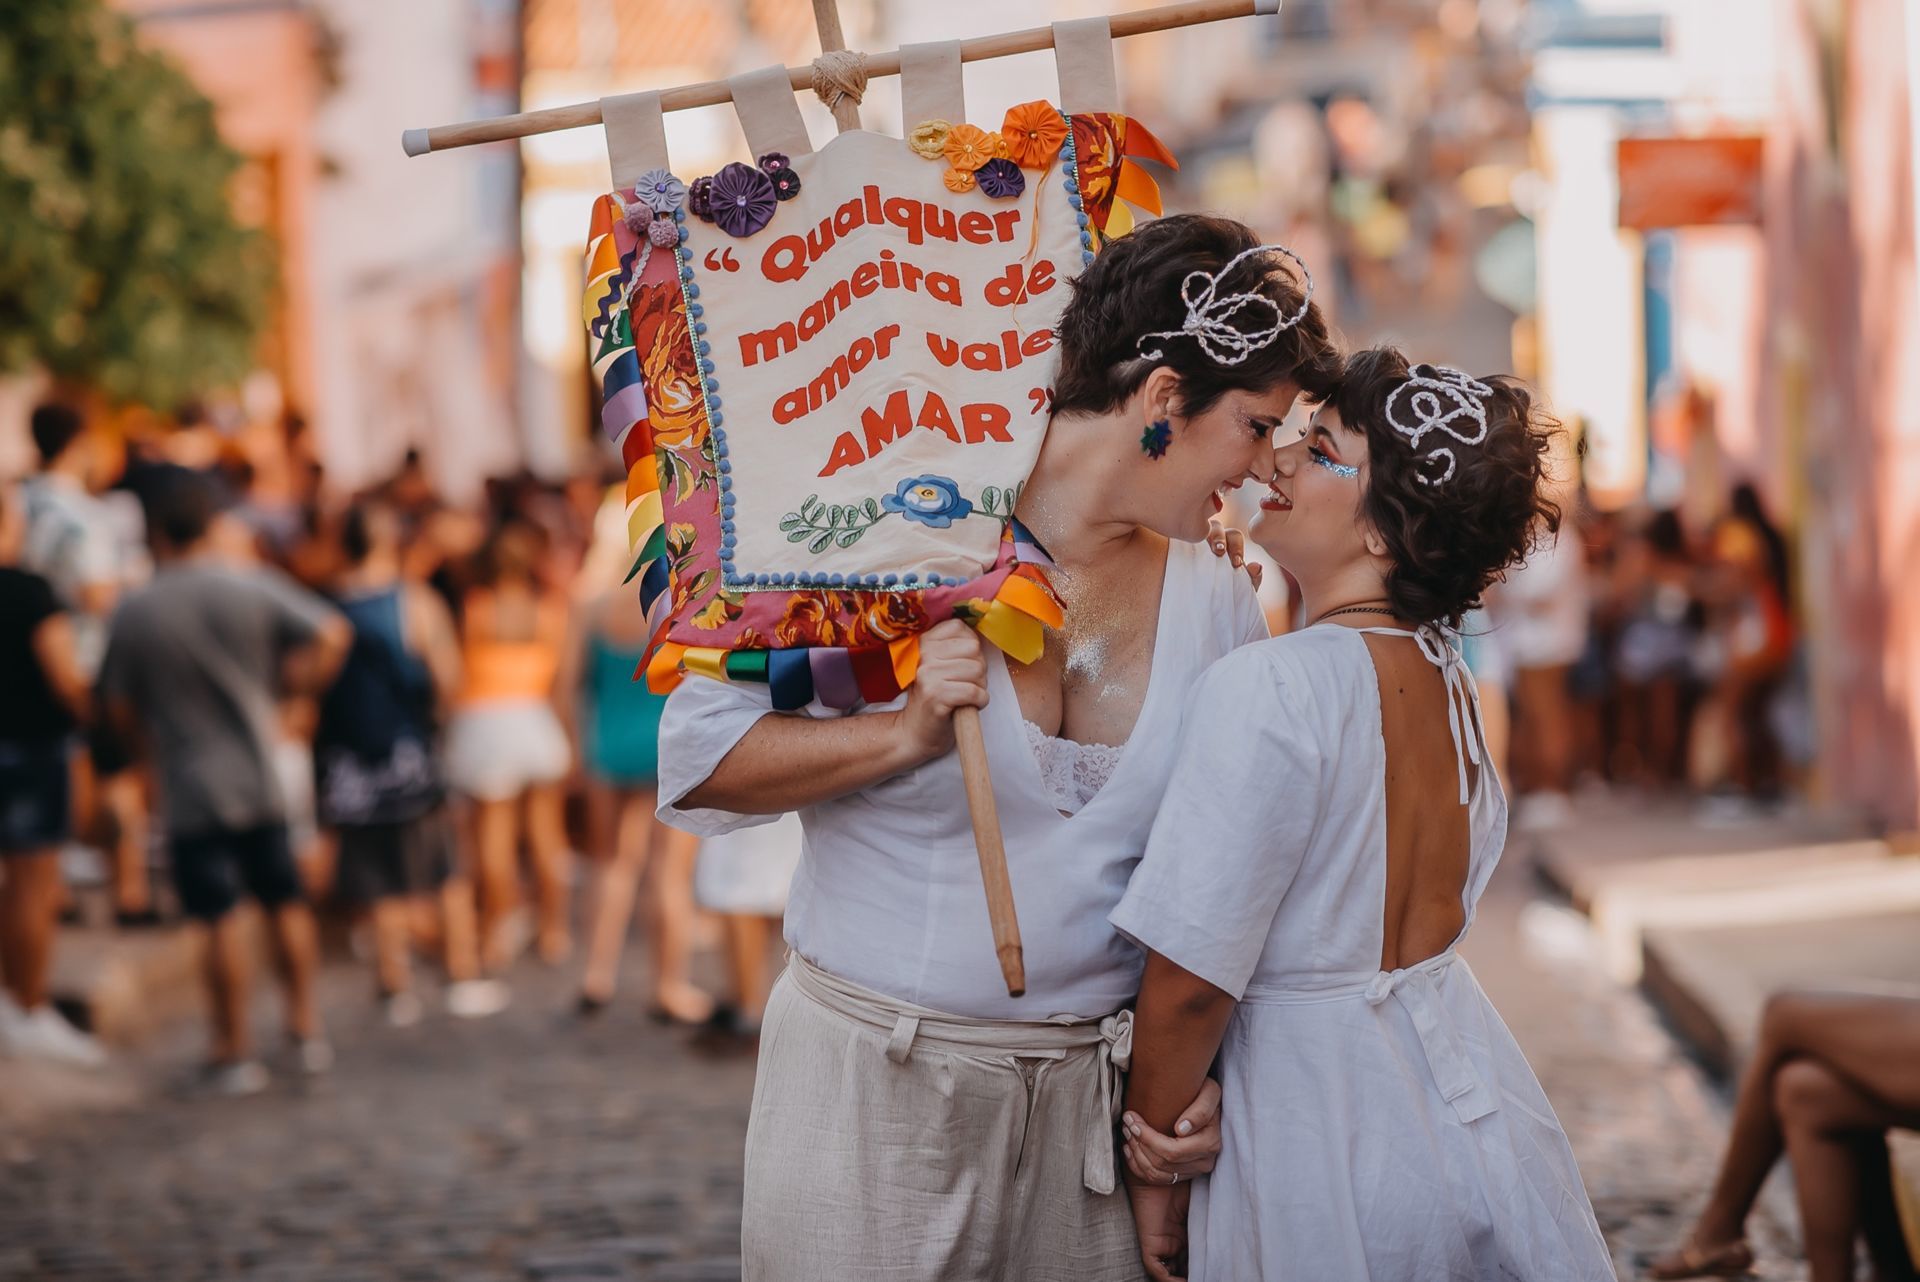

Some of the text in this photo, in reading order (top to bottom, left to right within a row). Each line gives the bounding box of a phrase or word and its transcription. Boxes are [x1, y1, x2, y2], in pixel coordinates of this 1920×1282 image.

[760, 184, 1021, 284] Qualquer
[738, 249, 1057, 368] maneira de
[772, 323, 1053, 425] amor vale
[817, 389, 1014, 478] AMAR
